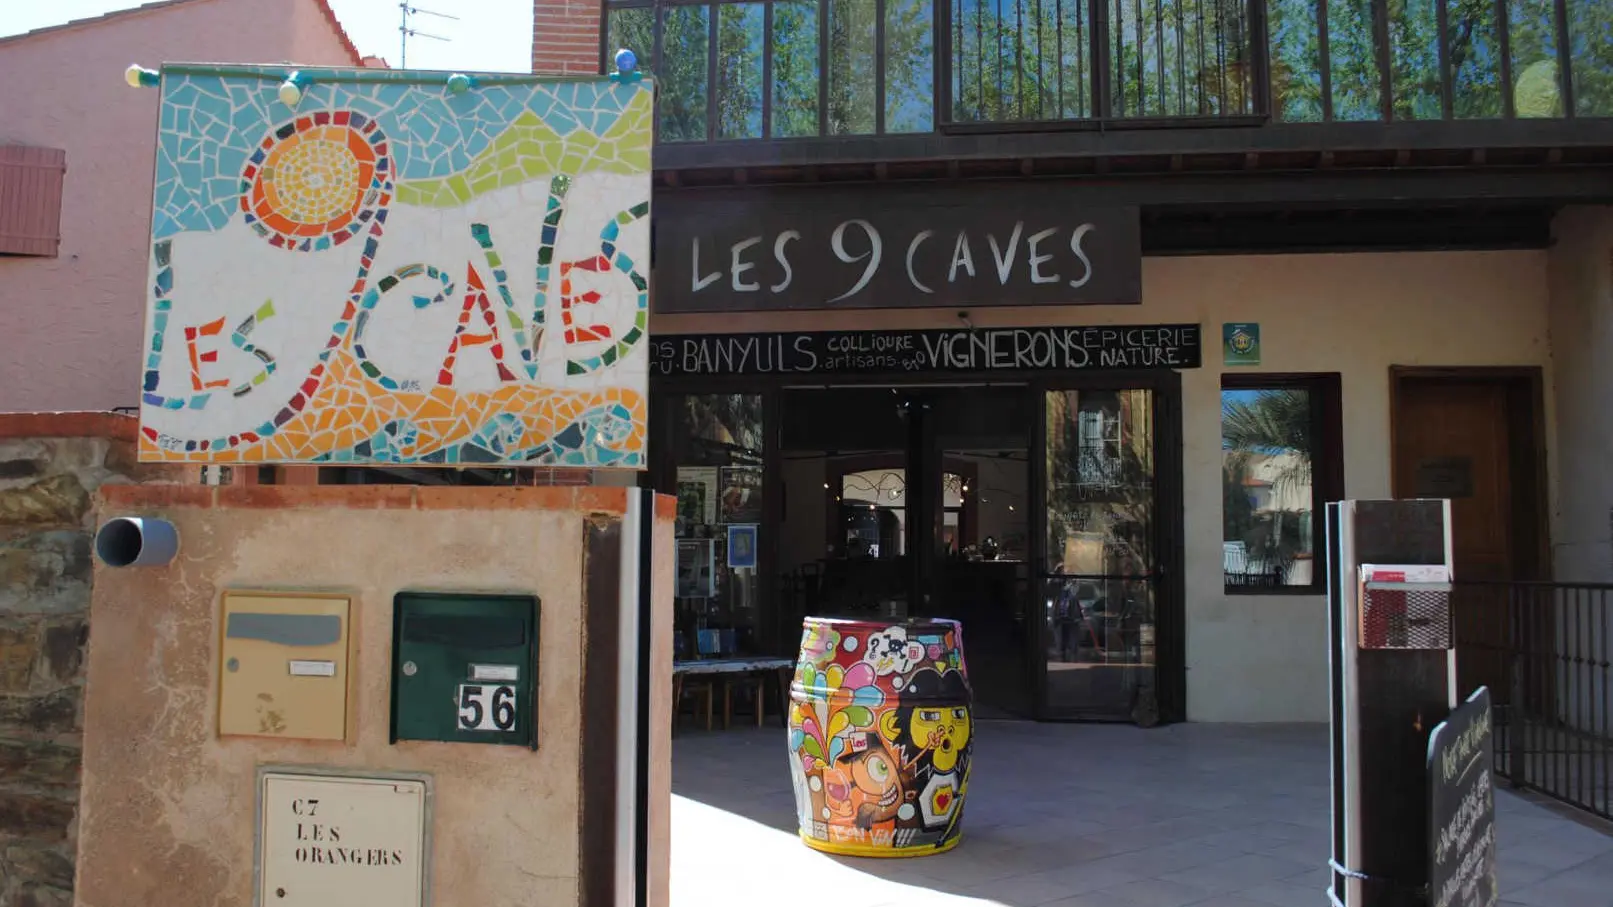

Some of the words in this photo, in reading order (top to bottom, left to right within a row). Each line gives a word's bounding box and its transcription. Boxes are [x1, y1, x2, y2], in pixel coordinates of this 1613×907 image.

[691, 229, 801, 293] LES
[827, 219, 882, 303] 9
[905, 220, 1095, 293] CAVES
[145, 239, 275, 409] LES
[355, 175, 649, 388] CAVES
[460, 686, 515, 731] 56
[298, 823, 340, 841] LES
[296, 847, 402, 866] ORANGERS
